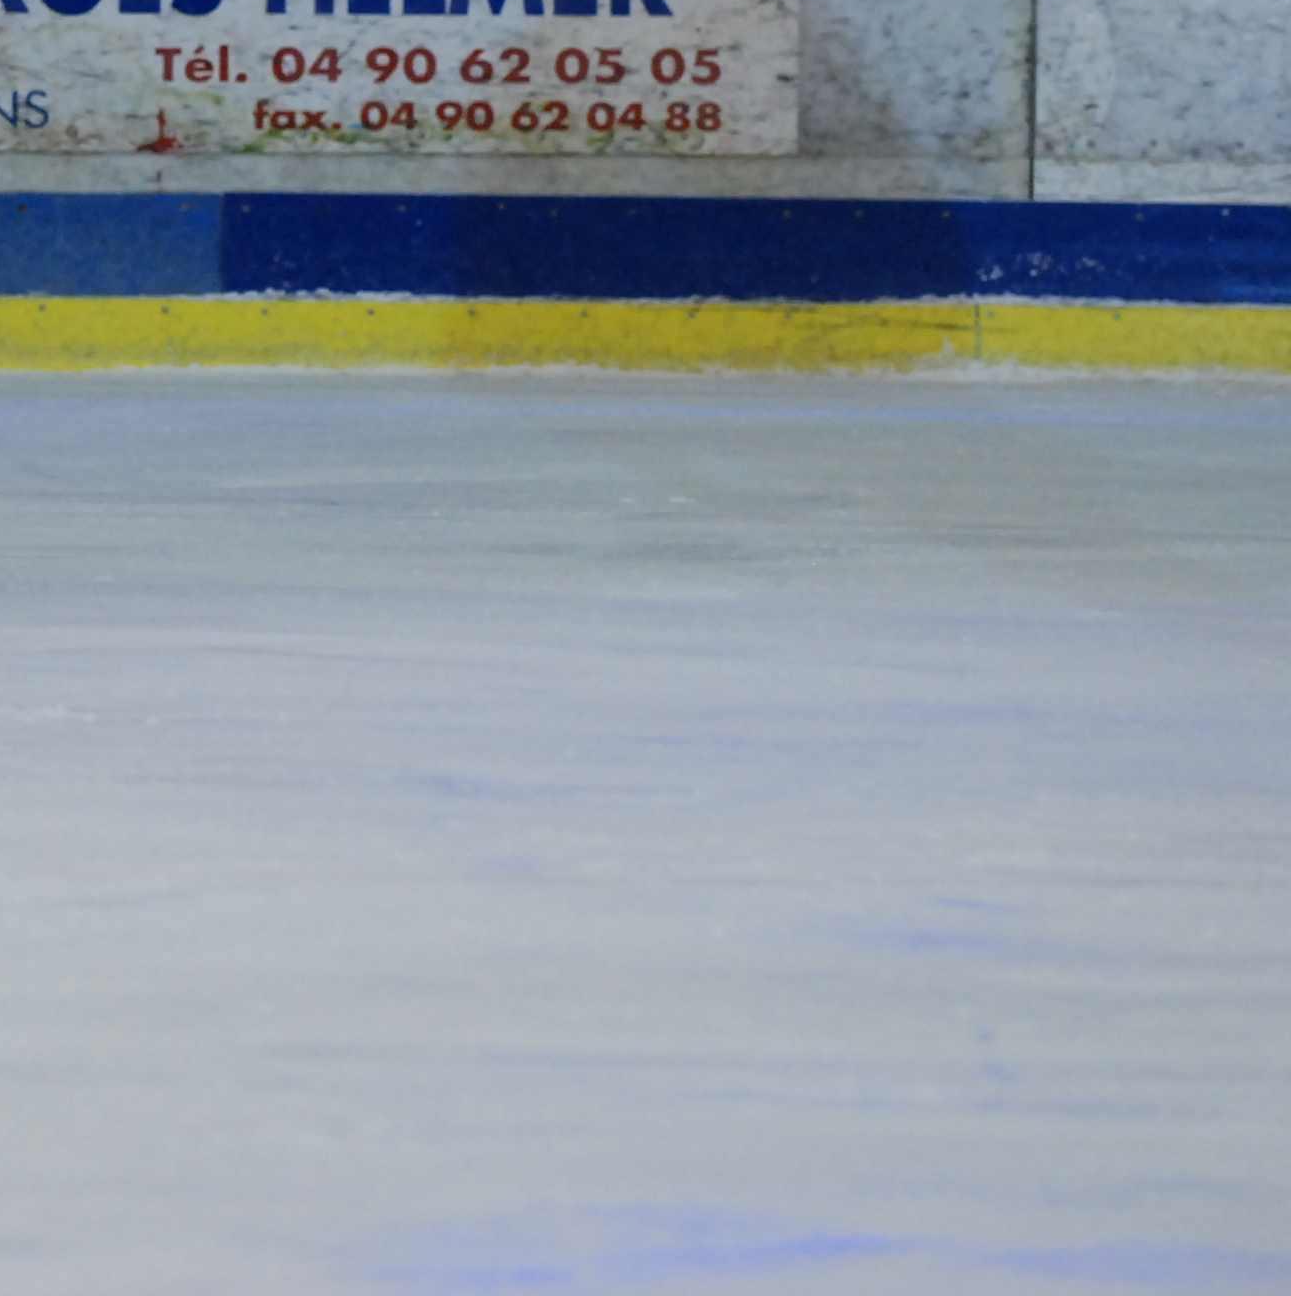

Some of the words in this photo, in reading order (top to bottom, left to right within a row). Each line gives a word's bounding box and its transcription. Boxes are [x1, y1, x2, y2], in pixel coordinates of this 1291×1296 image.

[155, 44, 248, 83] Tél.
[272, 46, 343, 84] 04
[365, 46, 437, 84] 90
[459, 47, 531, 84] 62
[554, 47, 625, 85] 05
[650, 47, 722, 85] 05
[252, 98, 342, 130] fax.
[360, 101, 418, 131] 04
[435, 100, 495, 132] 90
[510, 101, 570, 132] 62
[587, 101, 647, 132] 04
[664, 100, 723, 132] 88
